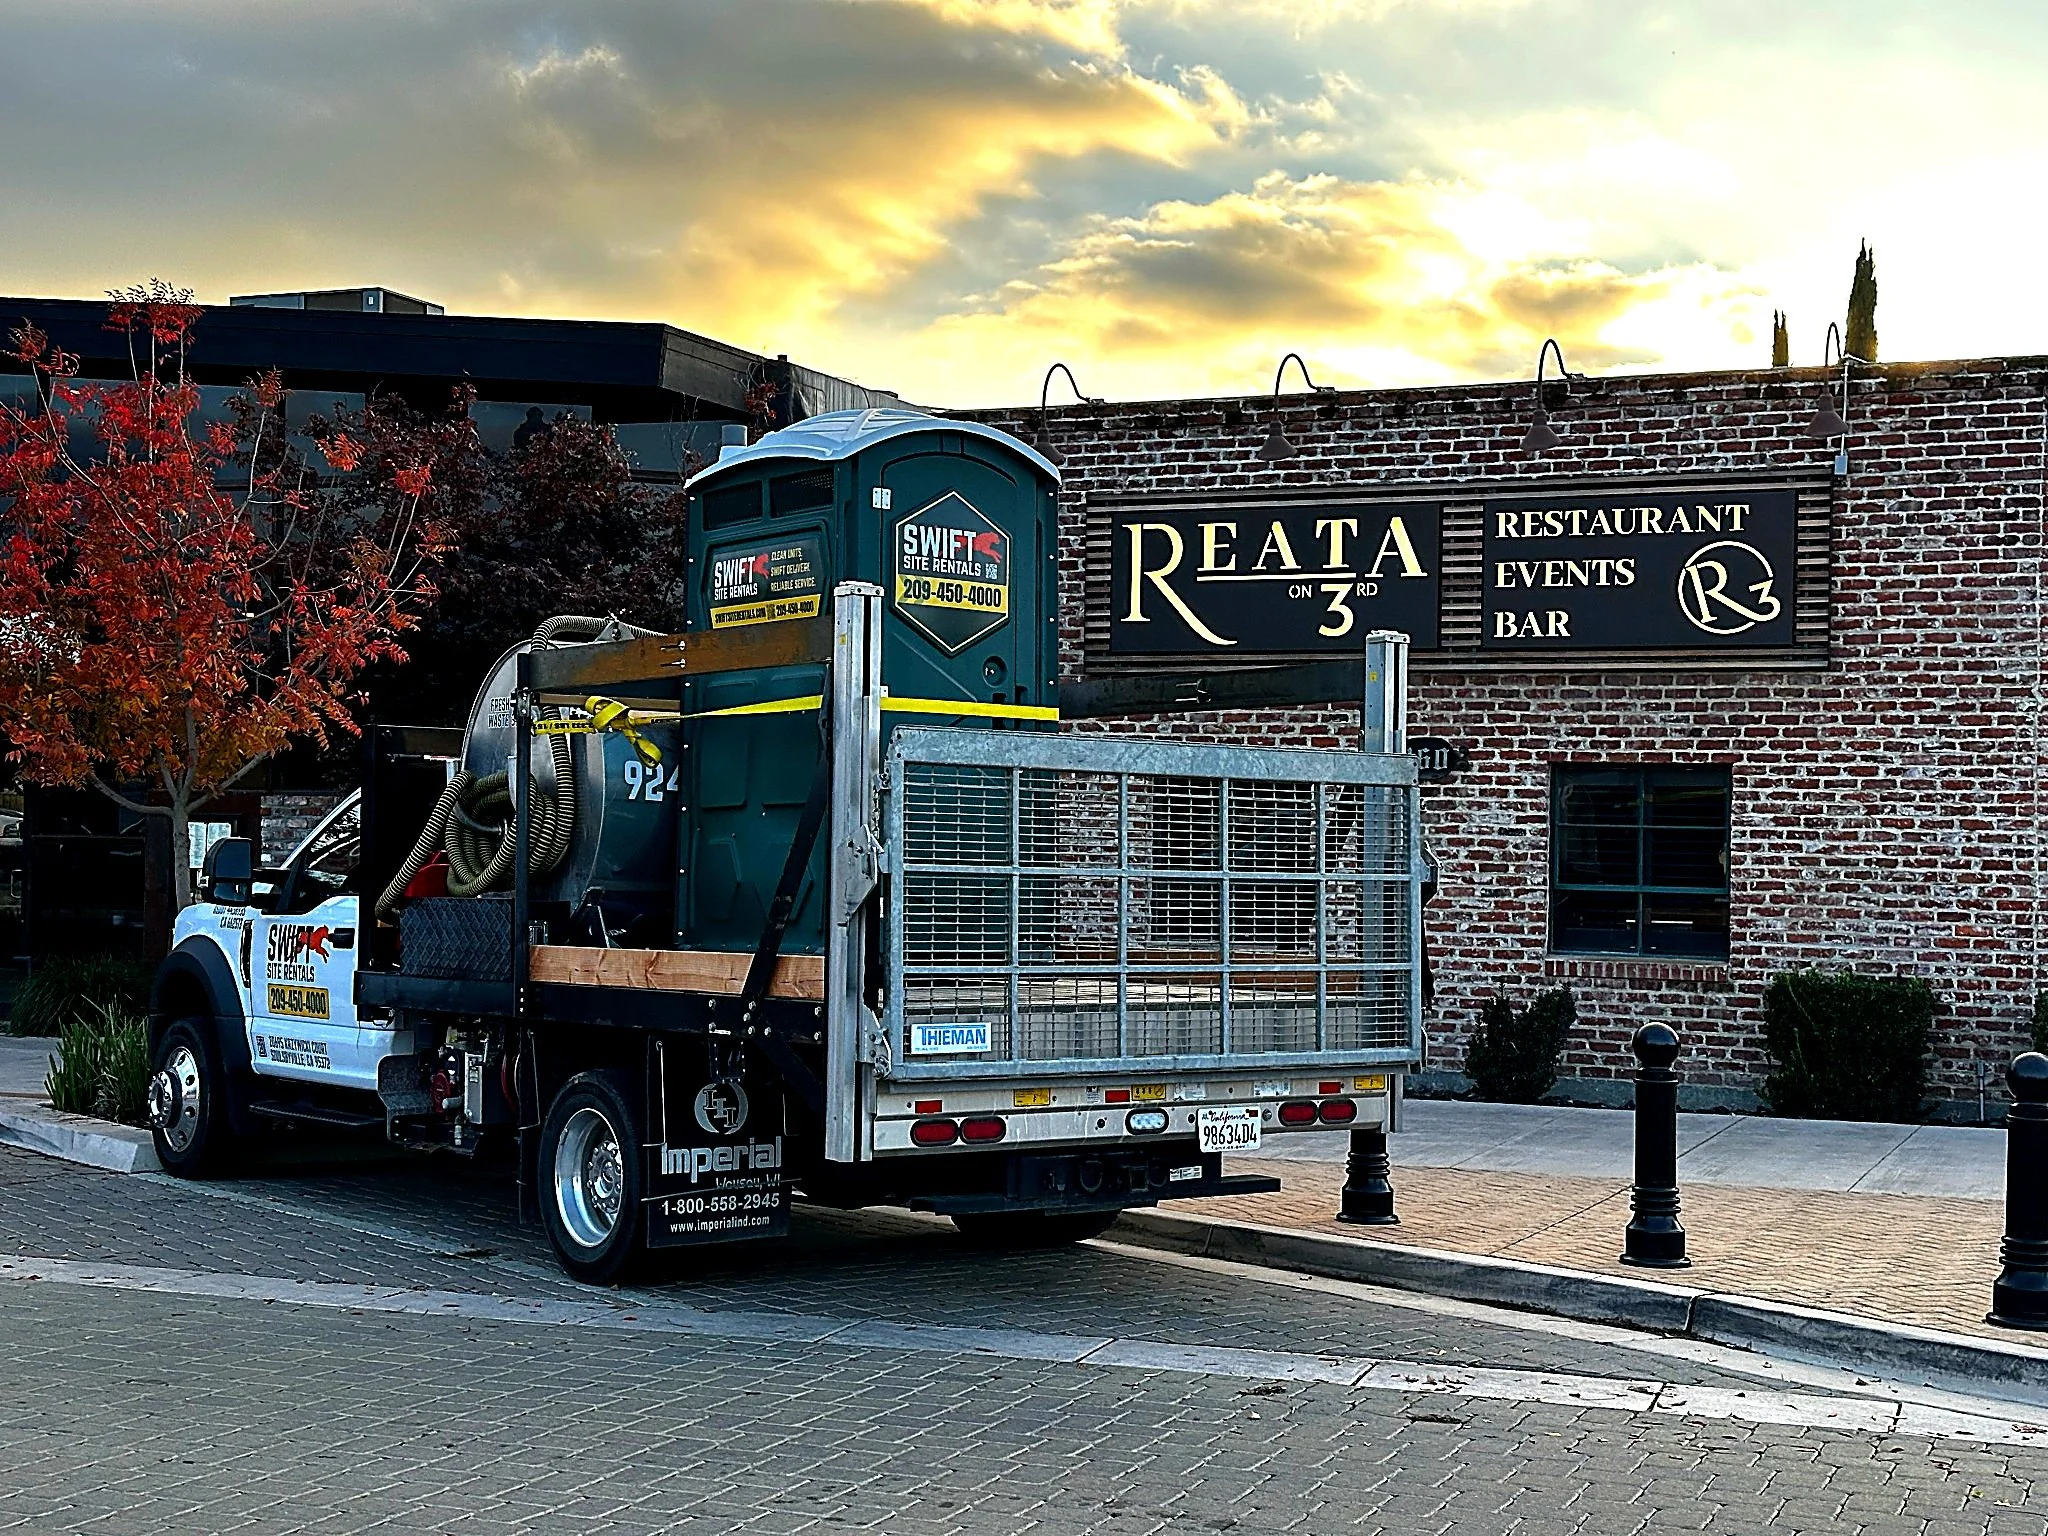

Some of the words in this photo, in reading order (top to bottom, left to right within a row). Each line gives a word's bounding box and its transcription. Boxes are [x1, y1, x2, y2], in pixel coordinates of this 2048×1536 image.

[1495, 504, 1750, 538] RESTAURANT
[903, 524, 977, 561] SWIFT
[714, 555, 756, 588] SWIFT
[903, 555, 930, 571] SITE
[932, 558, 982, 577] RENTALS
[1494, 559, 1635, 588] EVENTS
[714, 587, 728, 600] SITE
[729, 583, 758, 599] RENTALS
[1120, 516, 1428, 646] REATA
[1288, 584, 1312, 599] ON
[903, 579, 1002, 607] 209-450-4000
[775, 600, 814, 616] 209-450-4000
[1493, 610, 1571, 637] BAR
[490, 698, 510, 712] FRESH
[488, 713, 510, 728] WASTE
[267, 923, 315, 964] SWIFT
[266, 963, 282, 979] SITE
[283, 964, 315, 983] RENTALS
[270, 987, 327, 1014] 209-450-4000
[917, 1024, 987, 1046] THIEMAN
[1210, 1110, 1250, 1124] California
[1203, 1122, 1258, 1147] 98634D4
[766, 1173, 781, 1187] WI
[661, 1192, 780, 1215] 1-800-558-2945
[669, 1214, 770, 1233] www.imperialind.com
